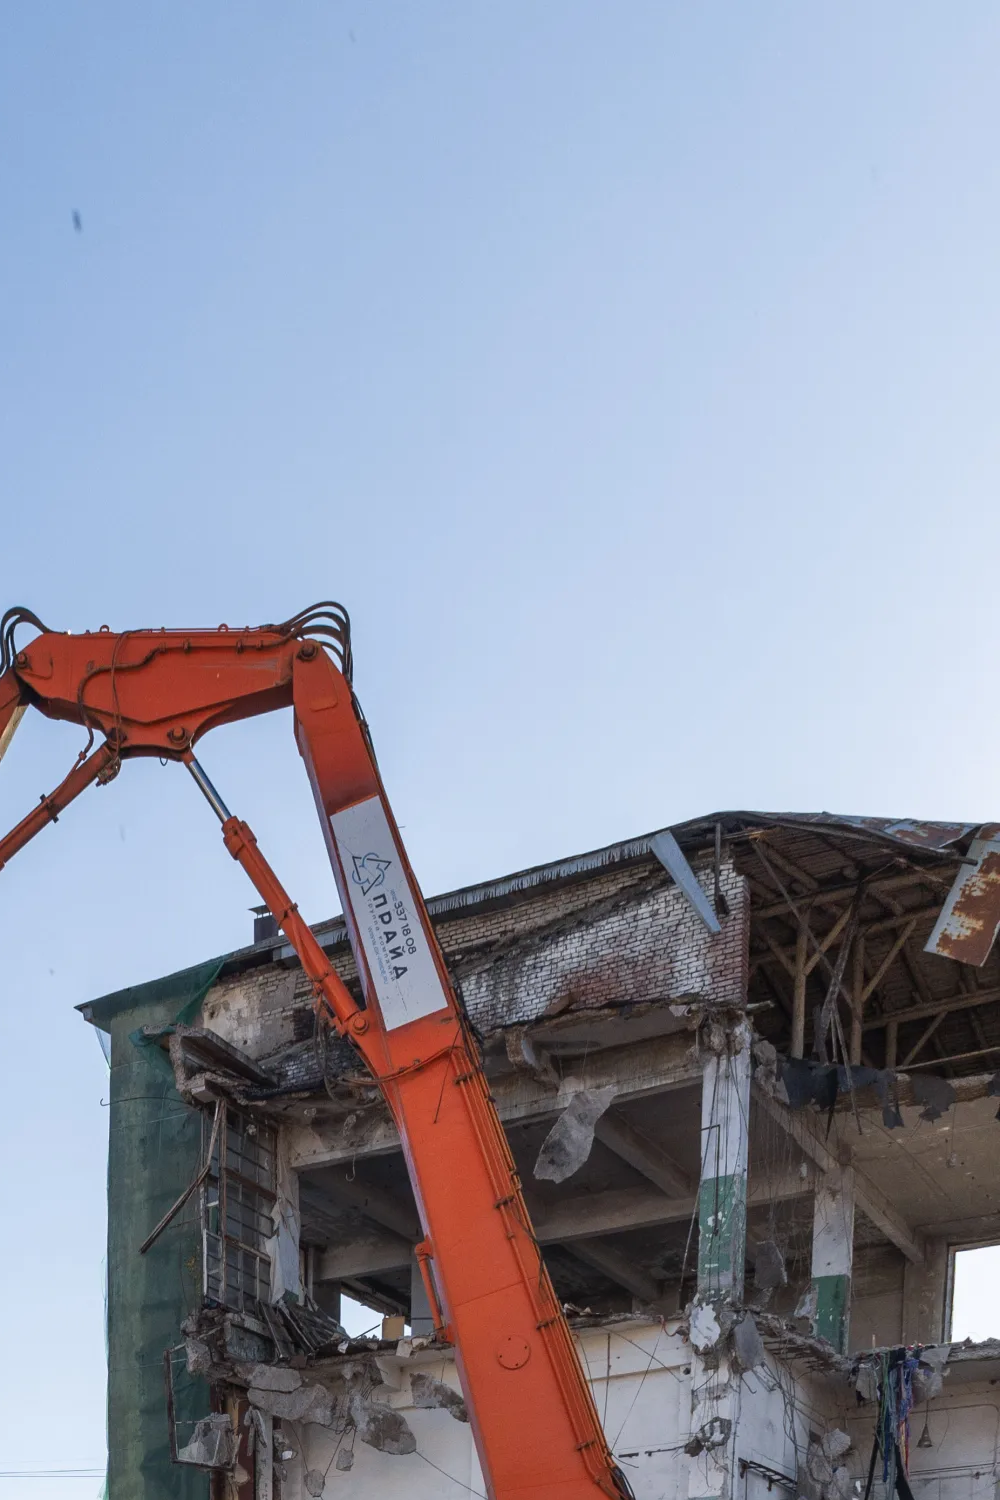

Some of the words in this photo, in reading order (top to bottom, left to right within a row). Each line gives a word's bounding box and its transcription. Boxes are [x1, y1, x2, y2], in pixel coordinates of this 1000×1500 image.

[394, 900, 408, 922] 337
[373, 893, 408, 980] ПРАЙД
[401, 923, 412, 937] 18
[405, 937, 417, 955] 08
